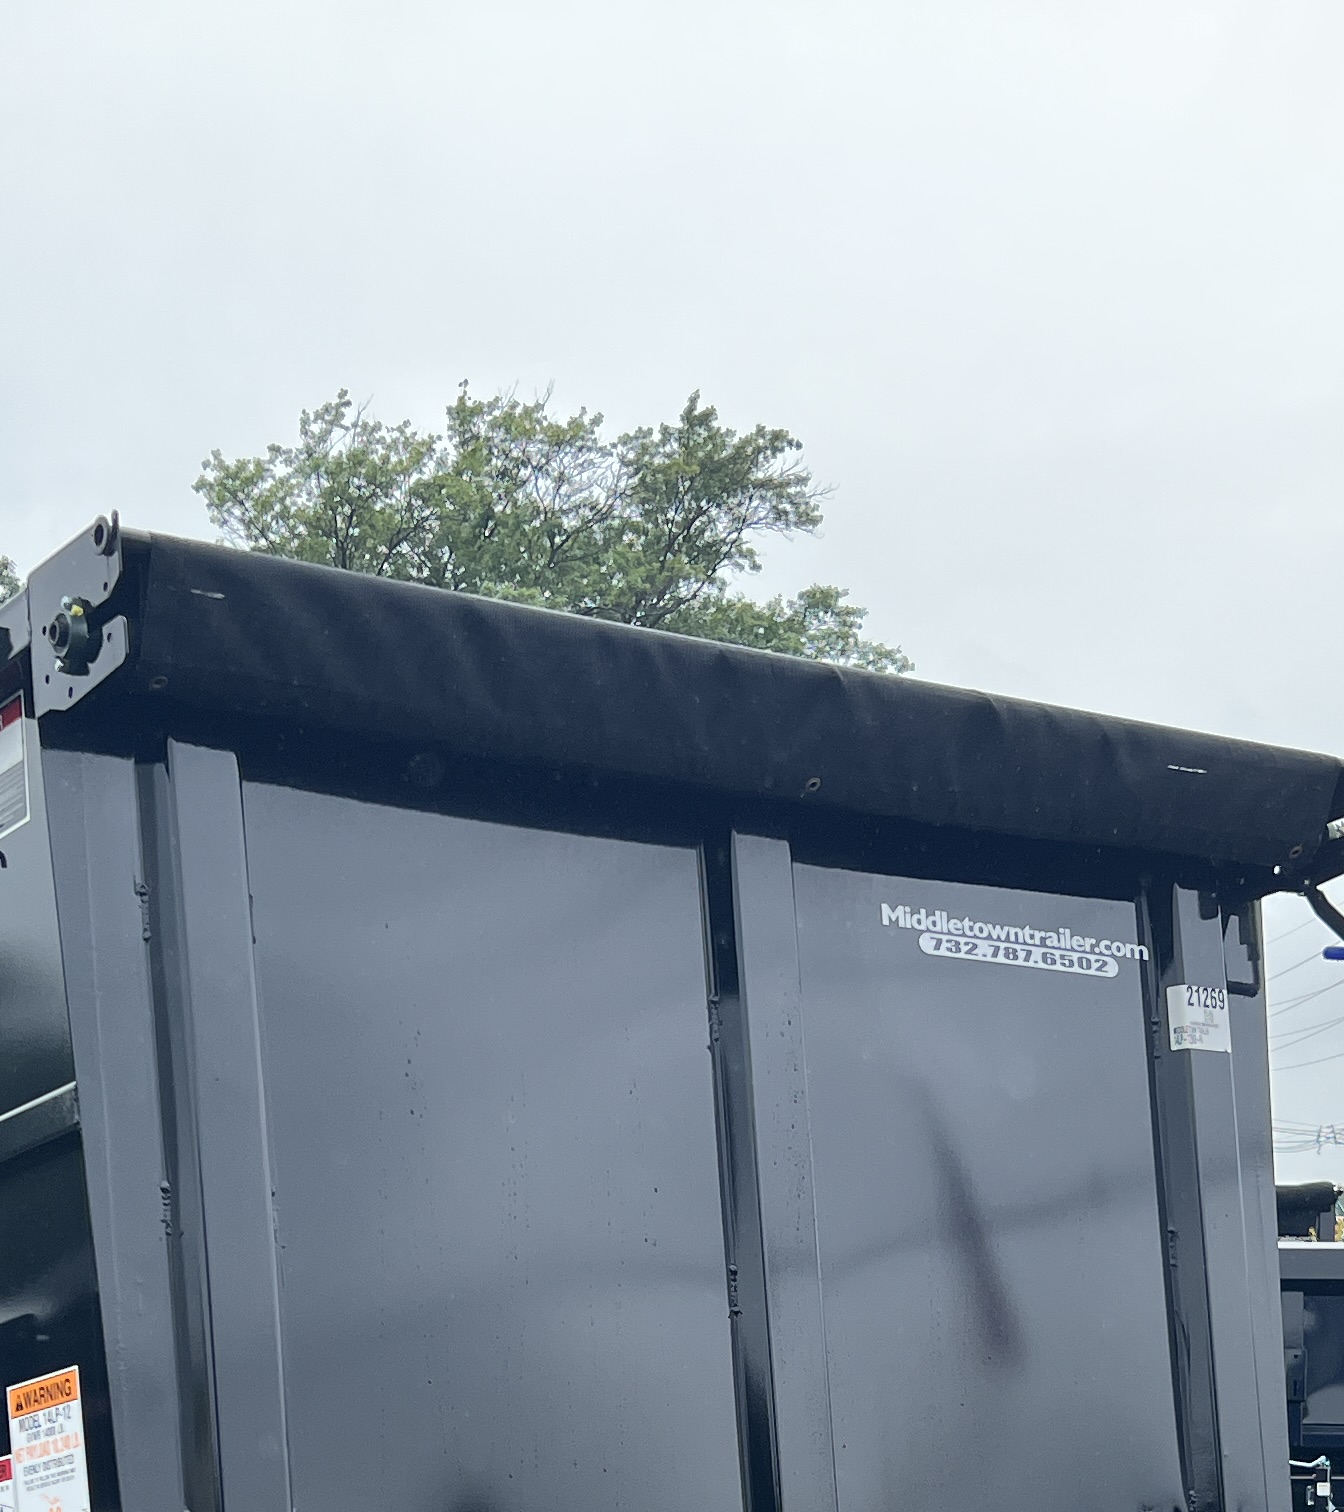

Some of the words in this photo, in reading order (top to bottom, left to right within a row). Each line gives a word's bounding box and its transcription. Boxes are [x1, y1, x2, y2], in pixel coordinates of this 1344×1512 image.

[881, 902, 1150, 961] Middletowntrailer.com
[929, 936, 1109, 974] 732.787.6502
[1186, 985, 1225, 1010] 21269
[22, 1378, 72, 1409] WARNING
